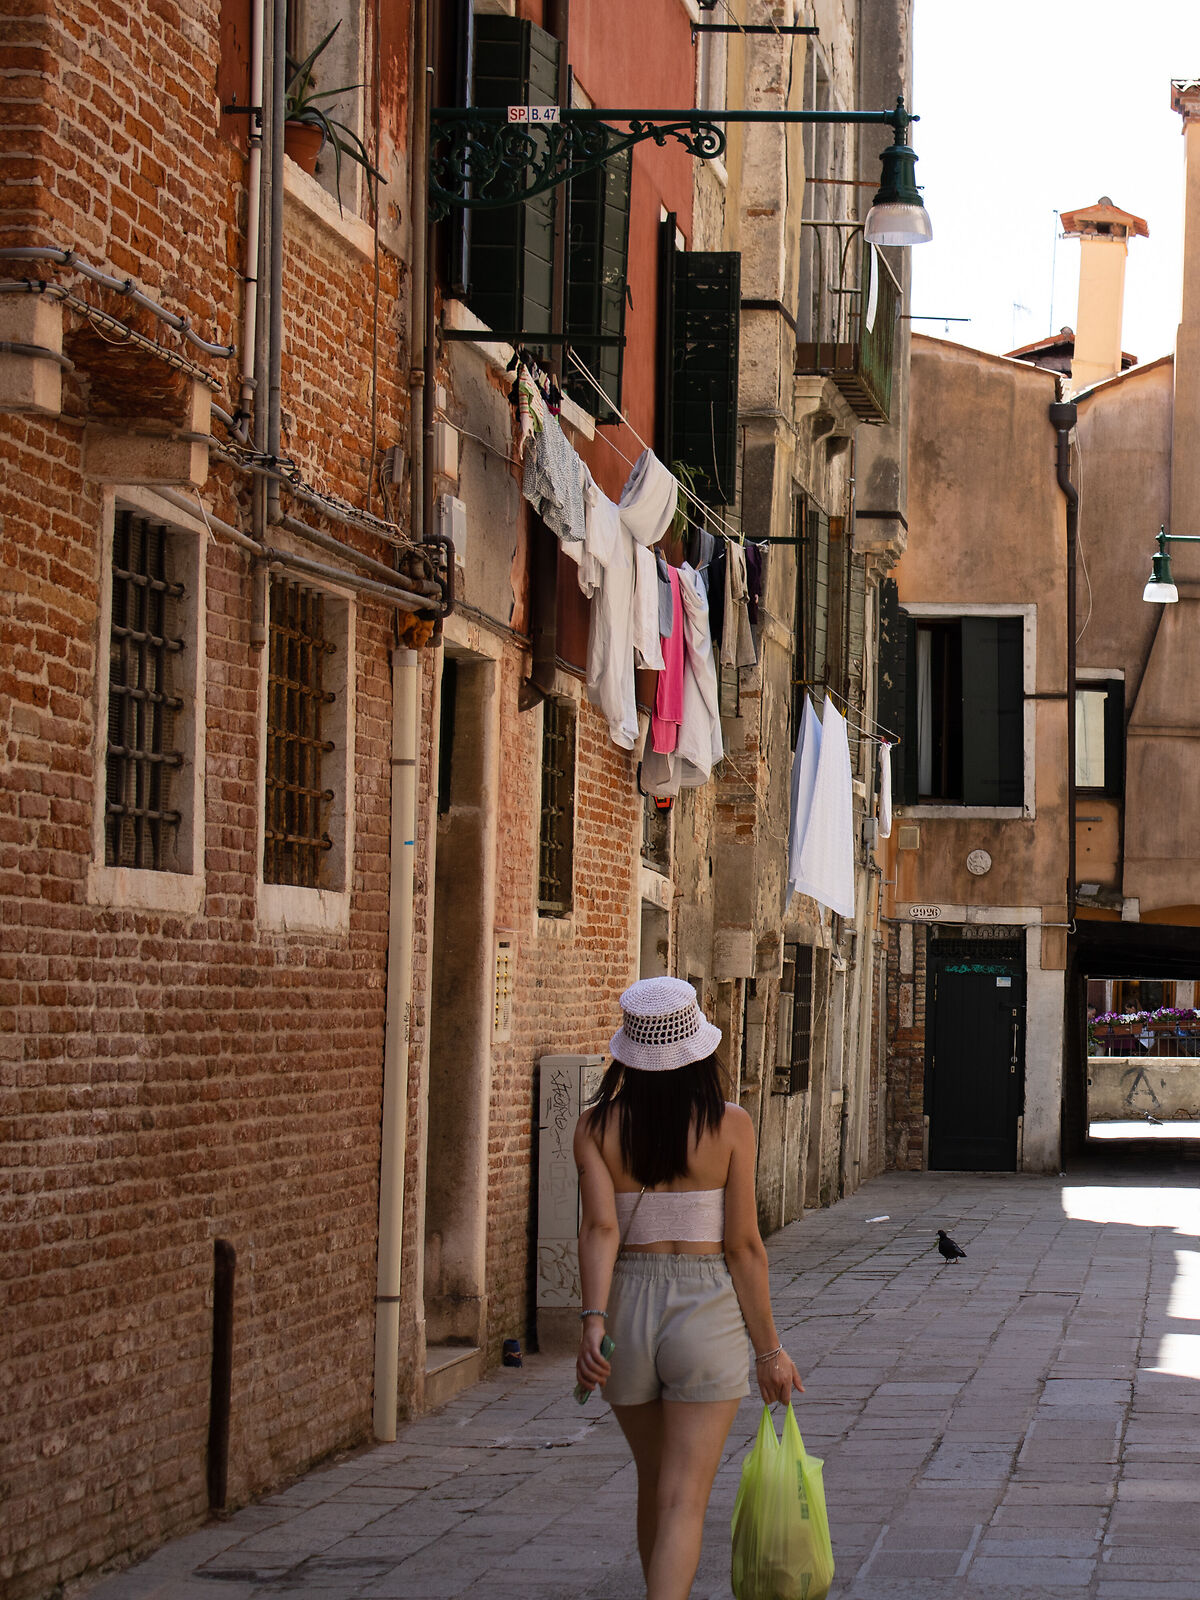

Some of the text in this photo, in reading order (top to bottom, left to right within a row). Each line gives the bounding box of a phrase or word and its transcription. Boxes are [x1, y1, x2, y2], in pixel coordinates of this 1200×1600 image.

[510, 108, 556, 121] SP. B. 47
[912, 908, 938, 917] 2926
